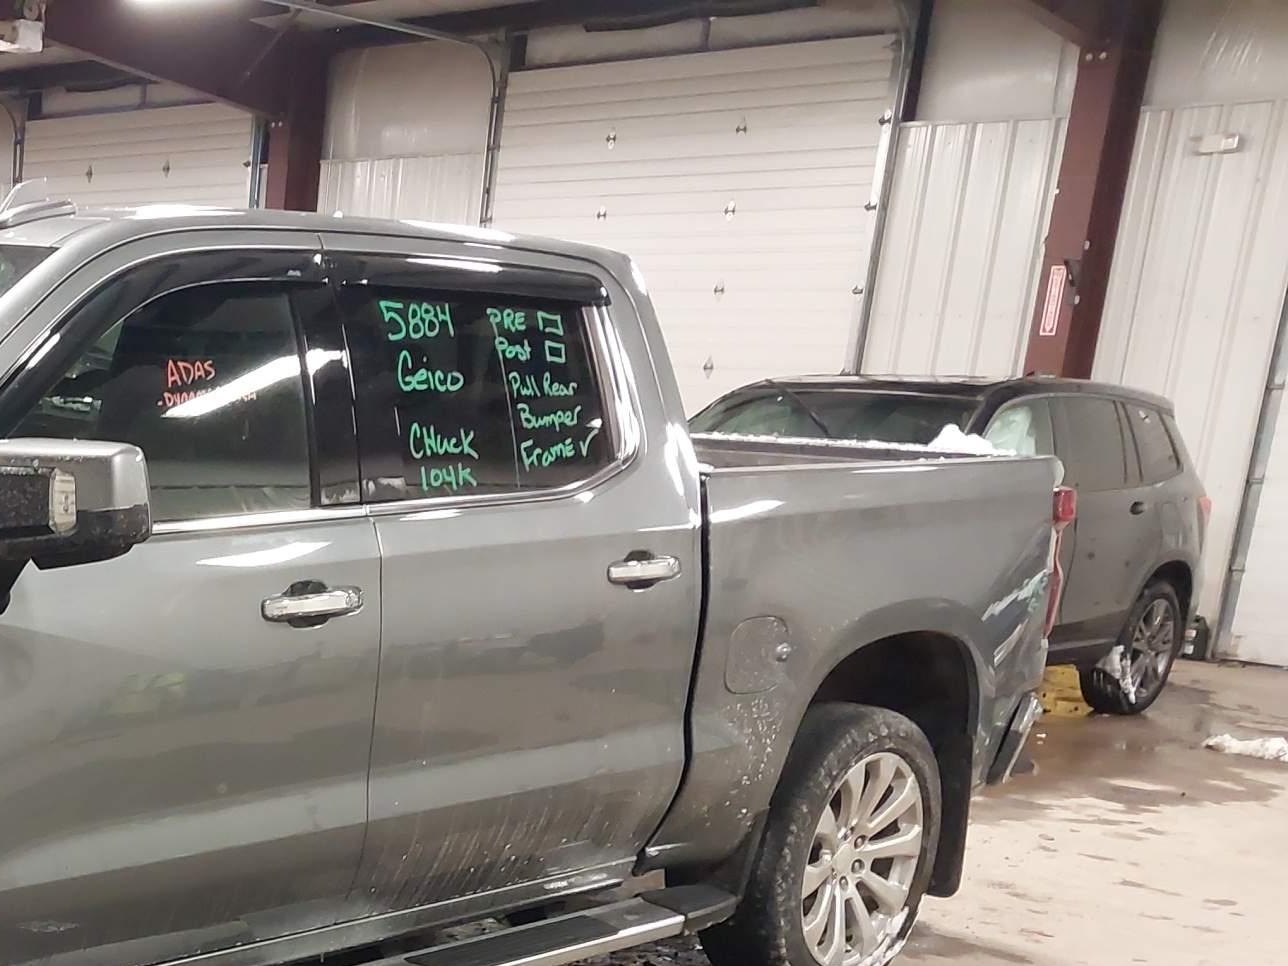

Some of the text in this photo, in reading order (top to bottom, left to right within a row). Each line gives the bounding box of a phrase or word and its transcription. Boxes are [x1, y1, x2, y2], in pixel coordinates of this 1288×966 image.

[379, 300, 455, 341] 5884
[486, 308, 527, 332] PRE
[168, 360, 215, 388] ADAS
[509, 372, 578, 398] Pull Rear
[517, 403, 582, 432] Bumper
